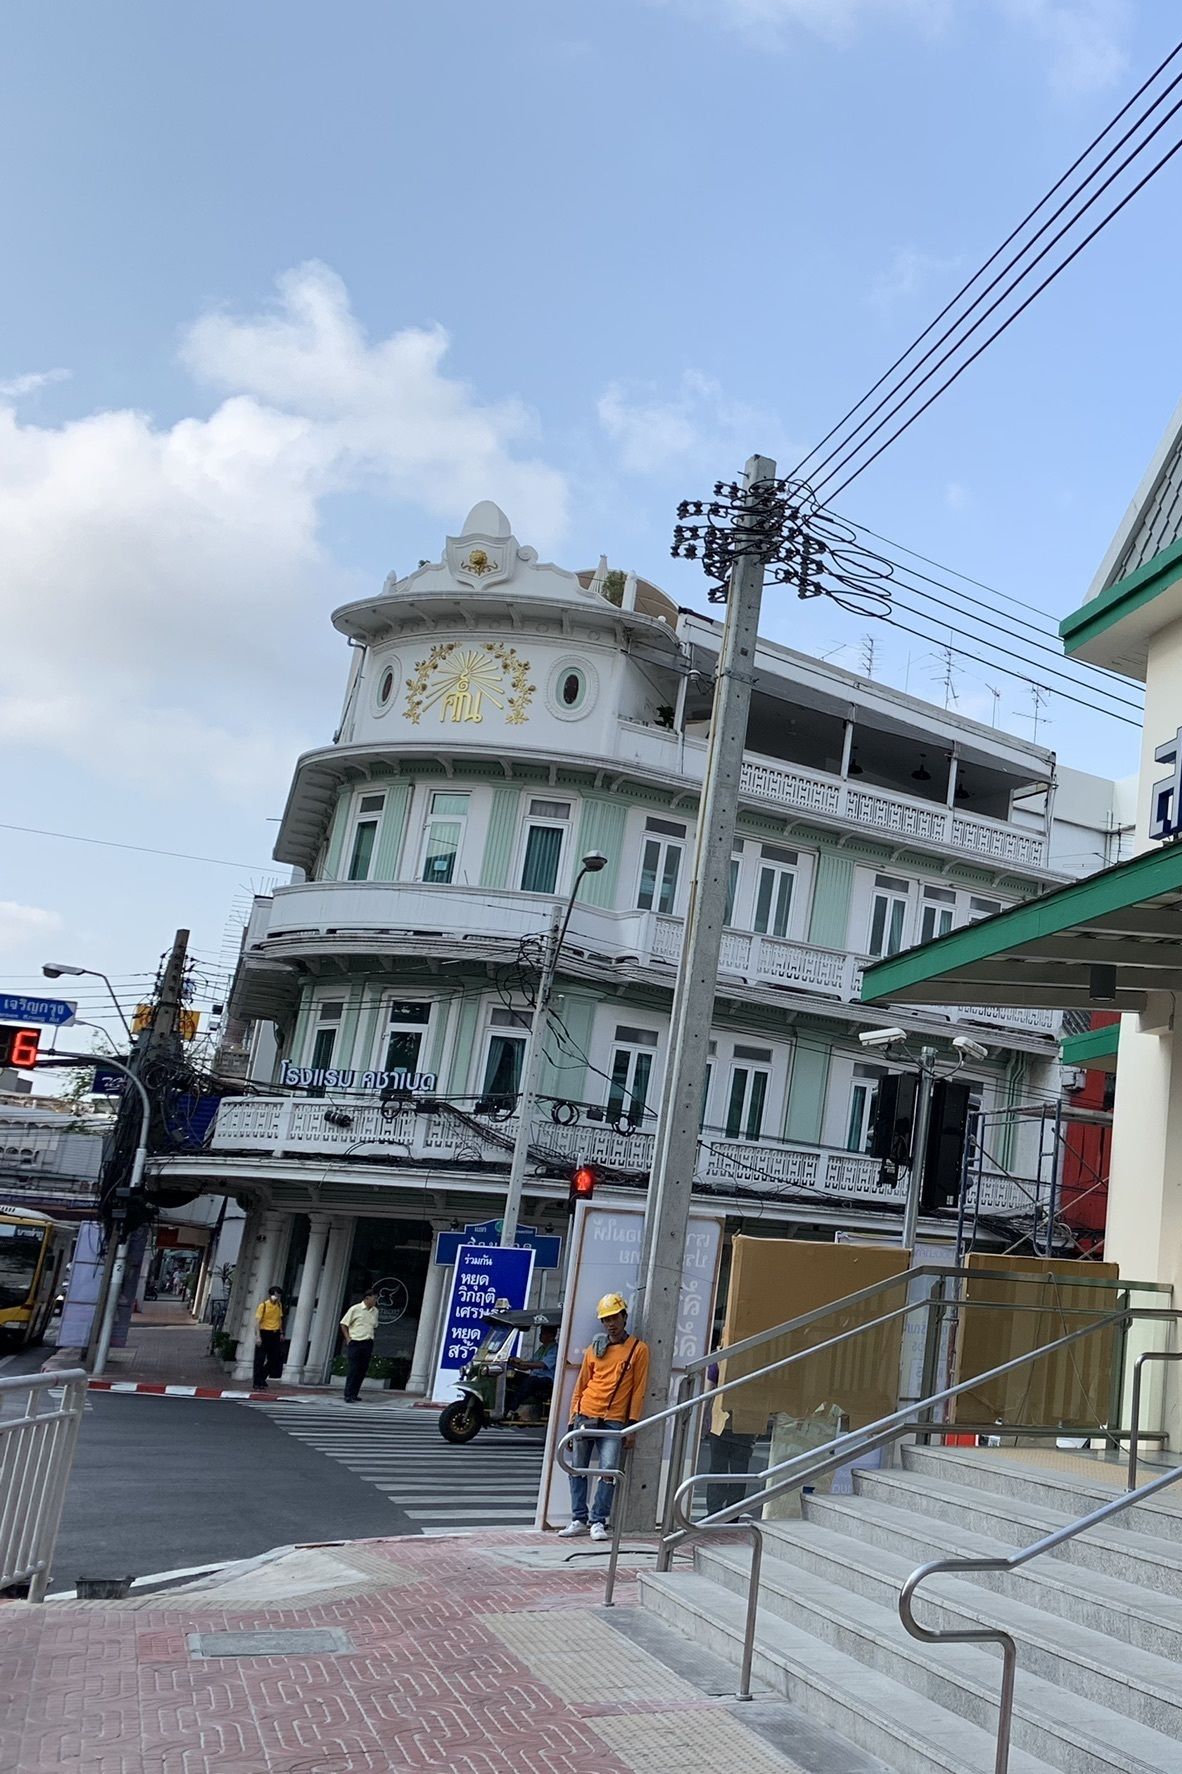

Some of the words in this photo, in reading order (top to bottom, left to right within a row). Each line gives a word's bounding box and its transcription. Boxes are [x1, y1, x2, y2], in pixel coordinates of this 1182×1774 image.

[12, 1030, 38, 1065] 6
[280, 1059, 353, 1087] โรงแรม
[464, 1253, 493, 1266] ร่วมกัน
[461, 1273, 490, 1291] หยุด
[458, 1285, 496, 1306] วิกฤติ
[451, 1327, 481, 1344] หยุด
